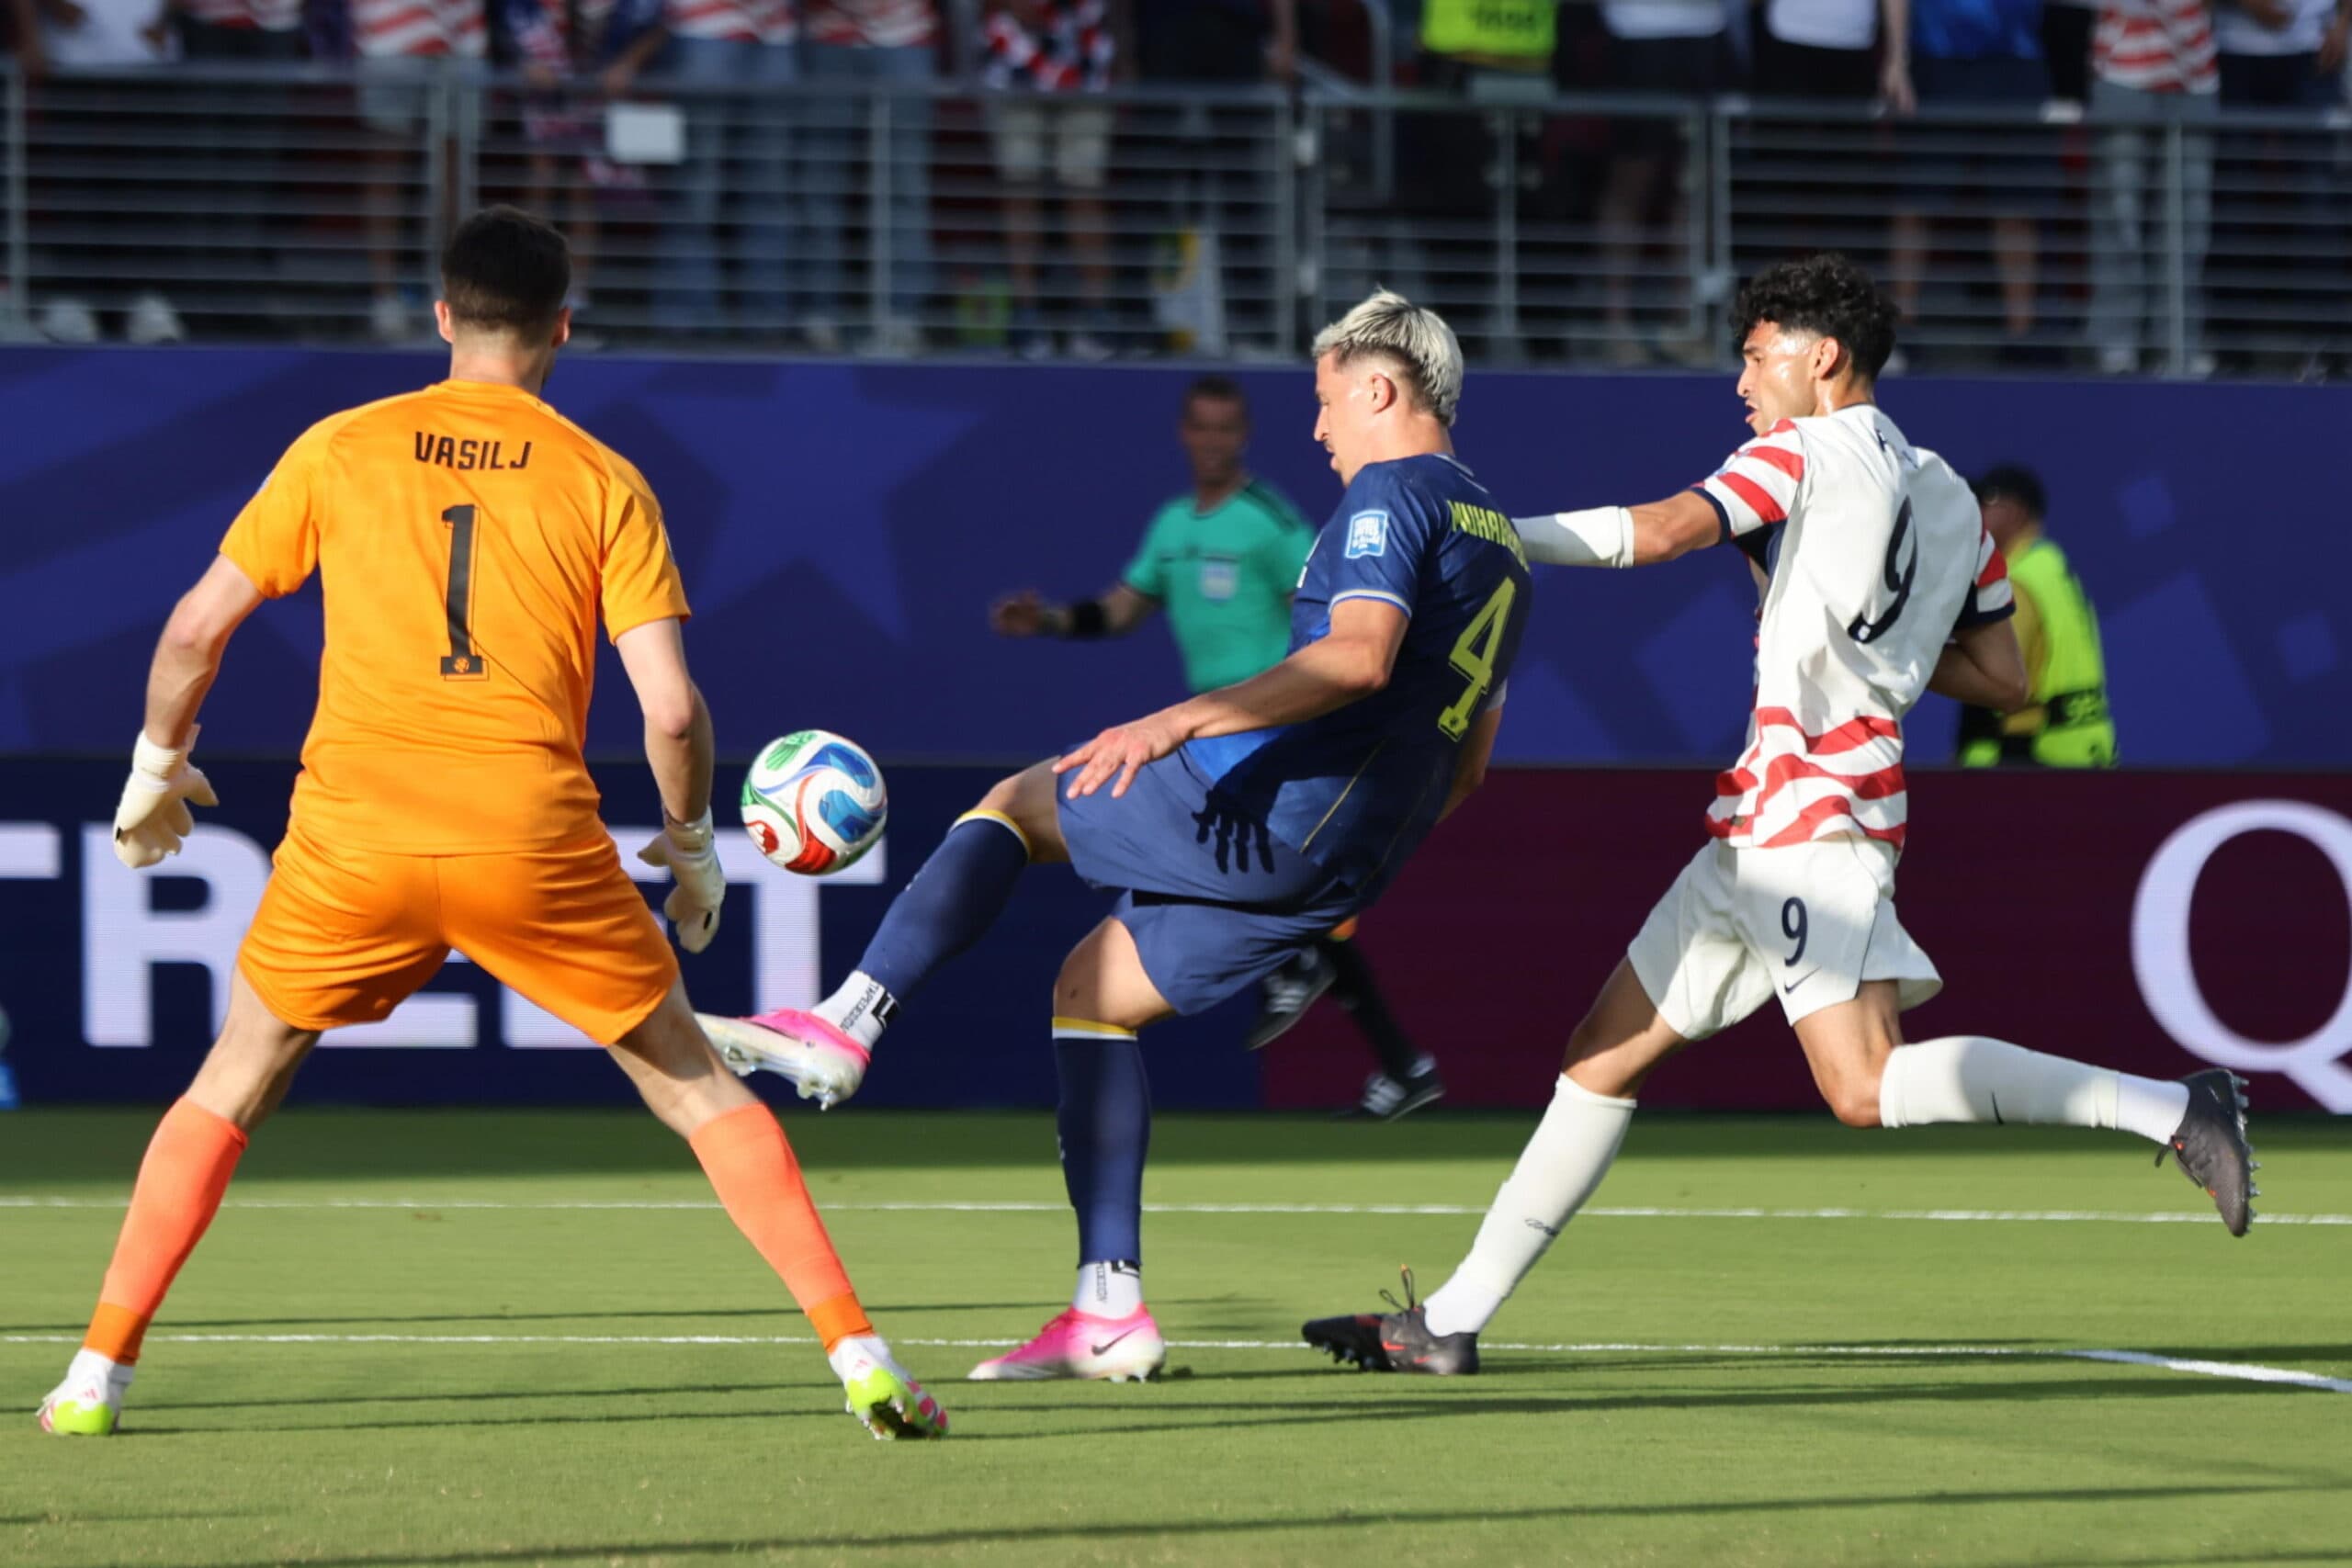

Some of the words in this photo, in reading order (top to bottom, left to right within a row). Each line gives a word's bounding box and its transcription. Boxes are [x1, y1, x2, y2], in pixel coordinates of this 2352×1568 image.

[414, 431, 532, 470] VASILJ
[440, 503, 485, 678] 1
[1848, 494, 1918, 644] 9
[1438, 577, 1515, 740] 4
[1781, 897, 1808, 967] 9
[2131, 797, 2352, 1115] Q
